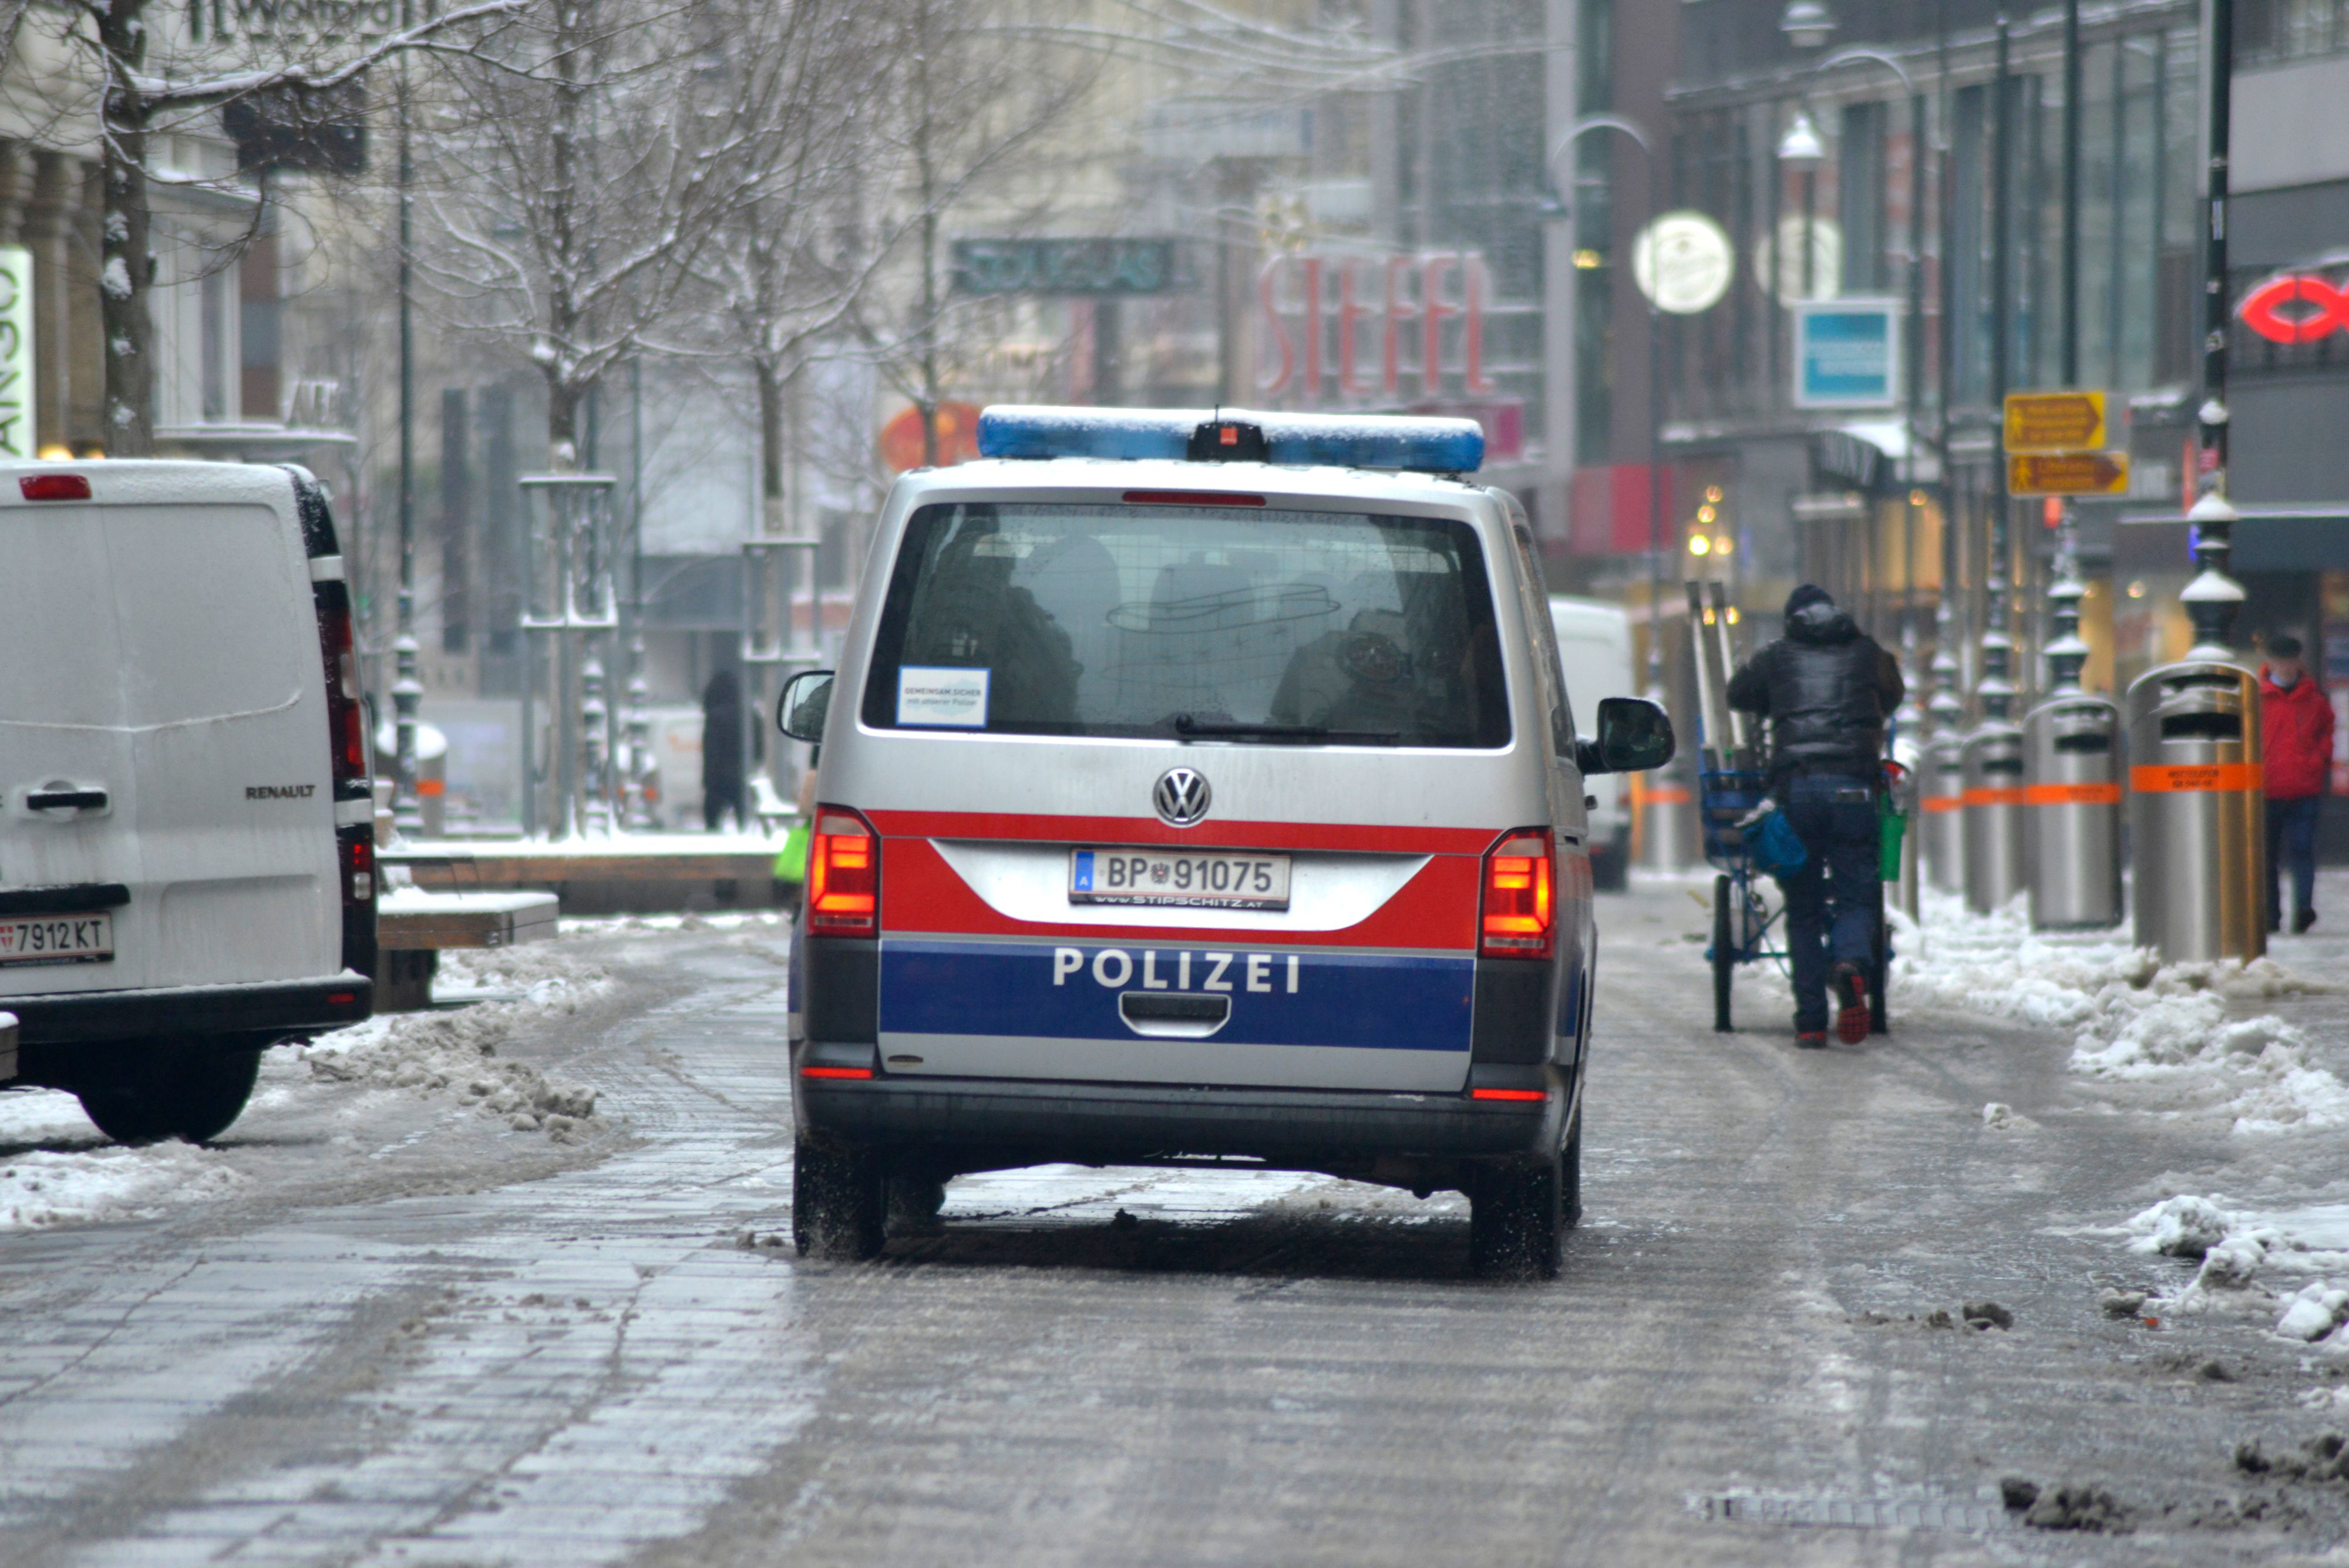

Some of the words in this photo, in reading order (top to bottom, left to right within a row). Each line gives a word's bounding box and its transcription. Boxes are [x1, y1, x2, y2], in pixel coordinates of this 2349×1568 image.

[245, 785, 315, 799] RENAULT
[1108, 857, 1148, 888] BP
[1174, 859, 1273, 893] 91075
[1054, 947, 1299, 994] POLIZEI
